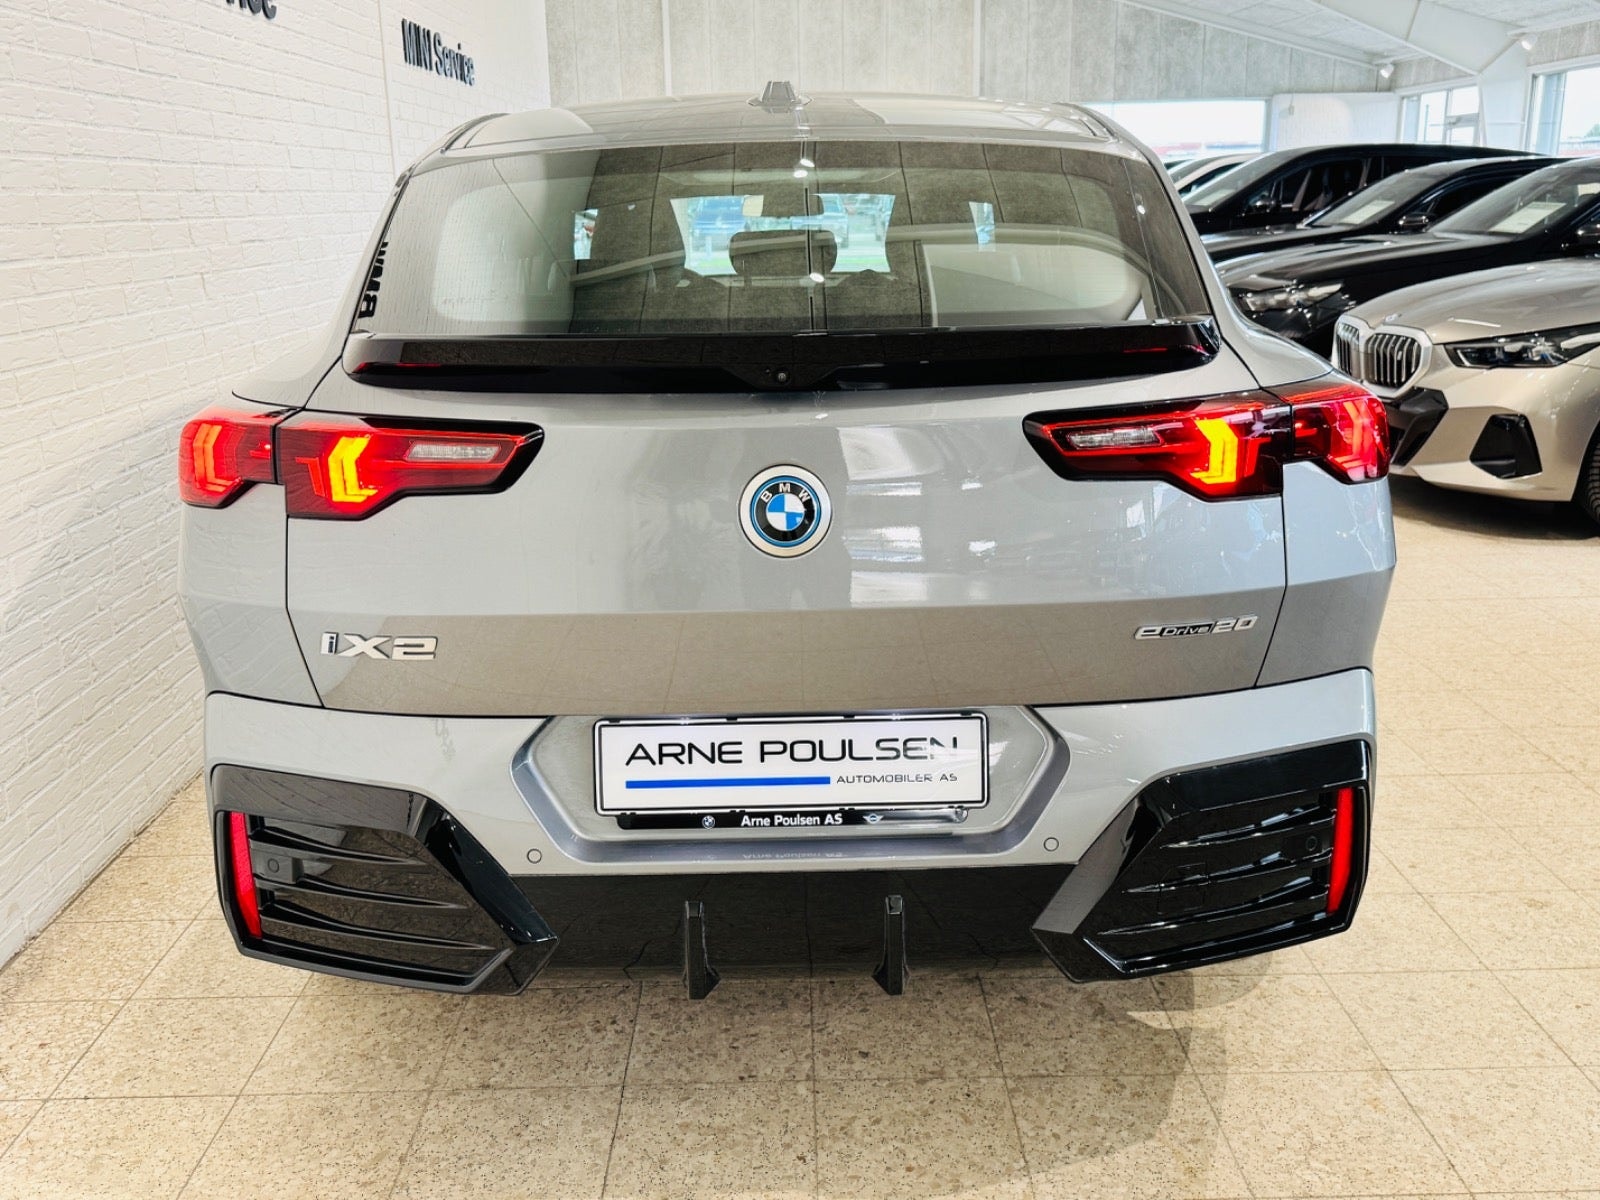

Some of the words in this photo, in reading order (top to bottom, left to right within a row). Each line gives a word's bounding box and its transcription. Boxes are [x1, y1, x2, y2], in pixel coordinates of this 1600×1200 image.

[401, 18, 433, 71] MINI
[433, 31, 476, 87] Service
[760, 482, 811, 503] BMW
[320, 631, 438, 661] iX2
[625, 741, 743, 766] ARNE
[760, 736, 958, 763] POULSEN
[836, 773, 933, 784] AUTOMOBILER
[939, 772, 958, 782] AS
[741, 815, 771, 827] Arne
[773, 813, 821, 826] Poulsen
[824, 813, 844, 825] AS
